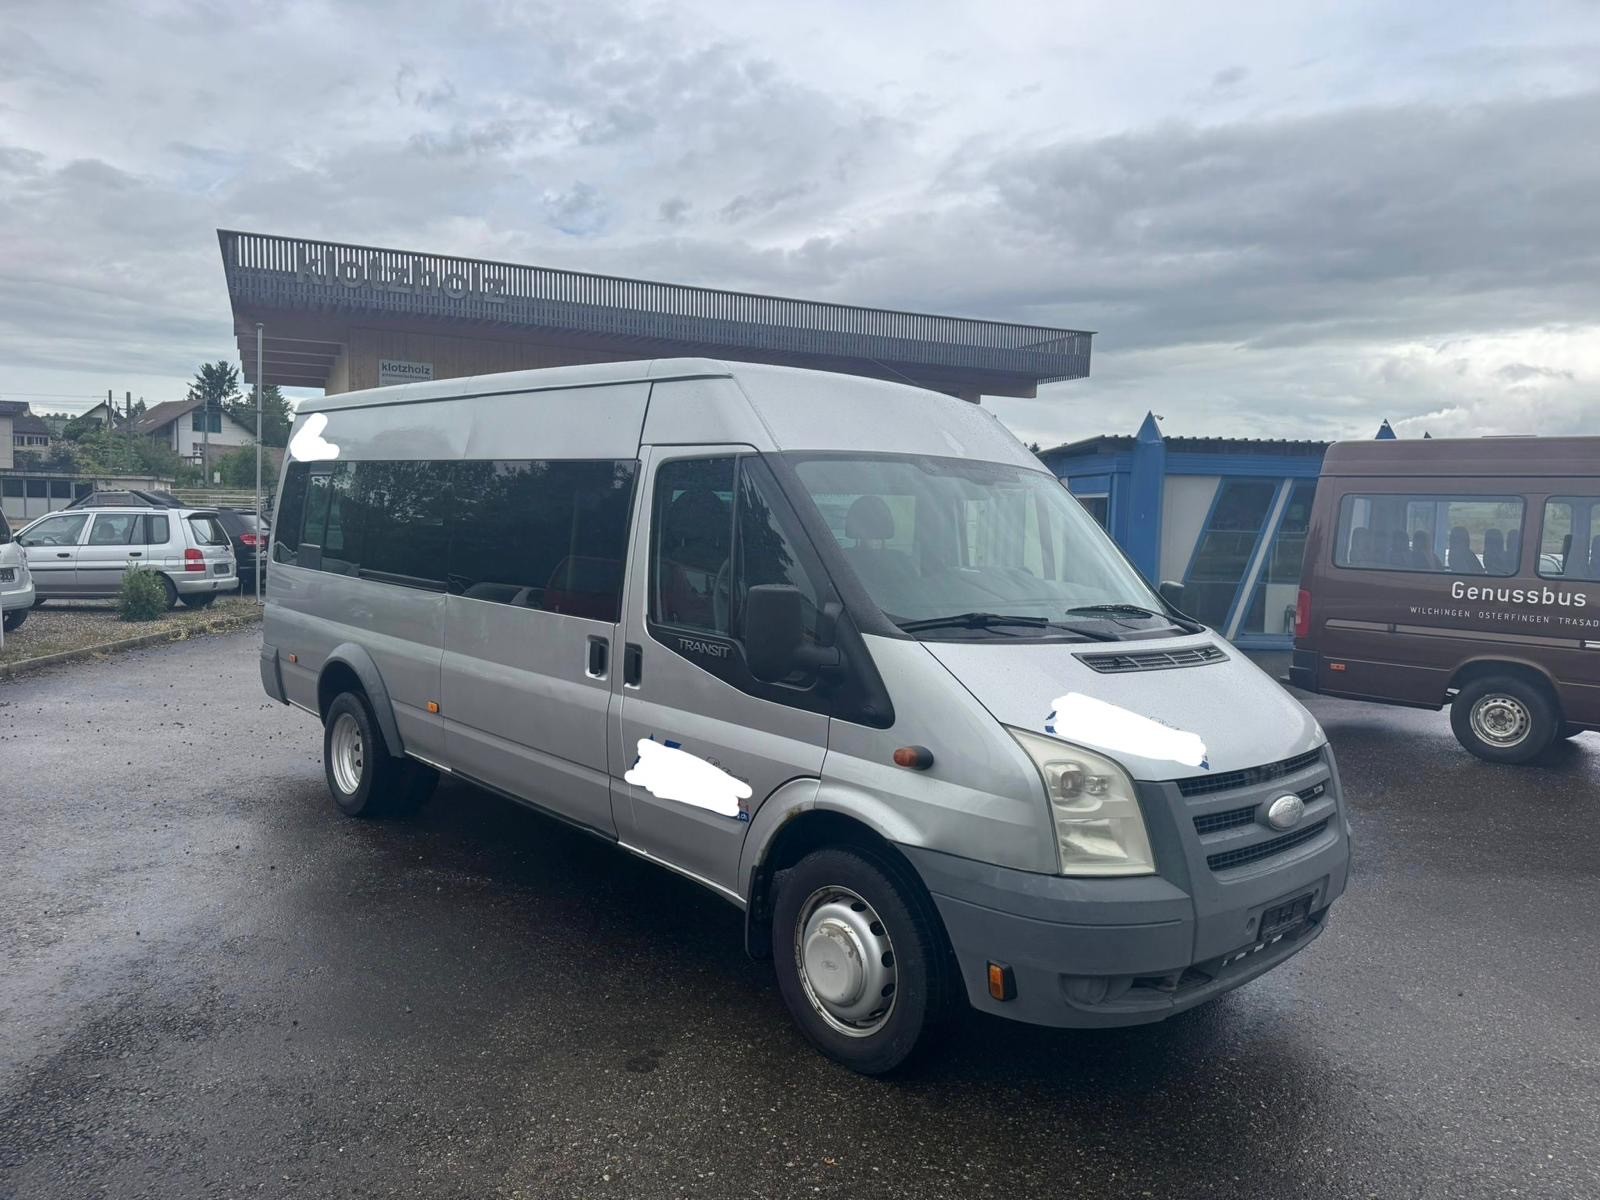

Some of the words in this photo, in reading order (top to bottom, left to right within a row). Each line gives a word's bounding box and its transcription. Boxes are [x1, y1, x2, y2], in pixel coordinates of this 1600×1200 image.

[296, 246, 506, 304] klotzholz
[381, 362, 431, 375] klotzholz
[1451, 581, 1587, 607] Genussbus
[1410, 606, 1471, 618] WILCHINGEN
[1478, 611, 1550, 624] OSTERFINGEN
[678, 638, 730, 658] TRANSIT
